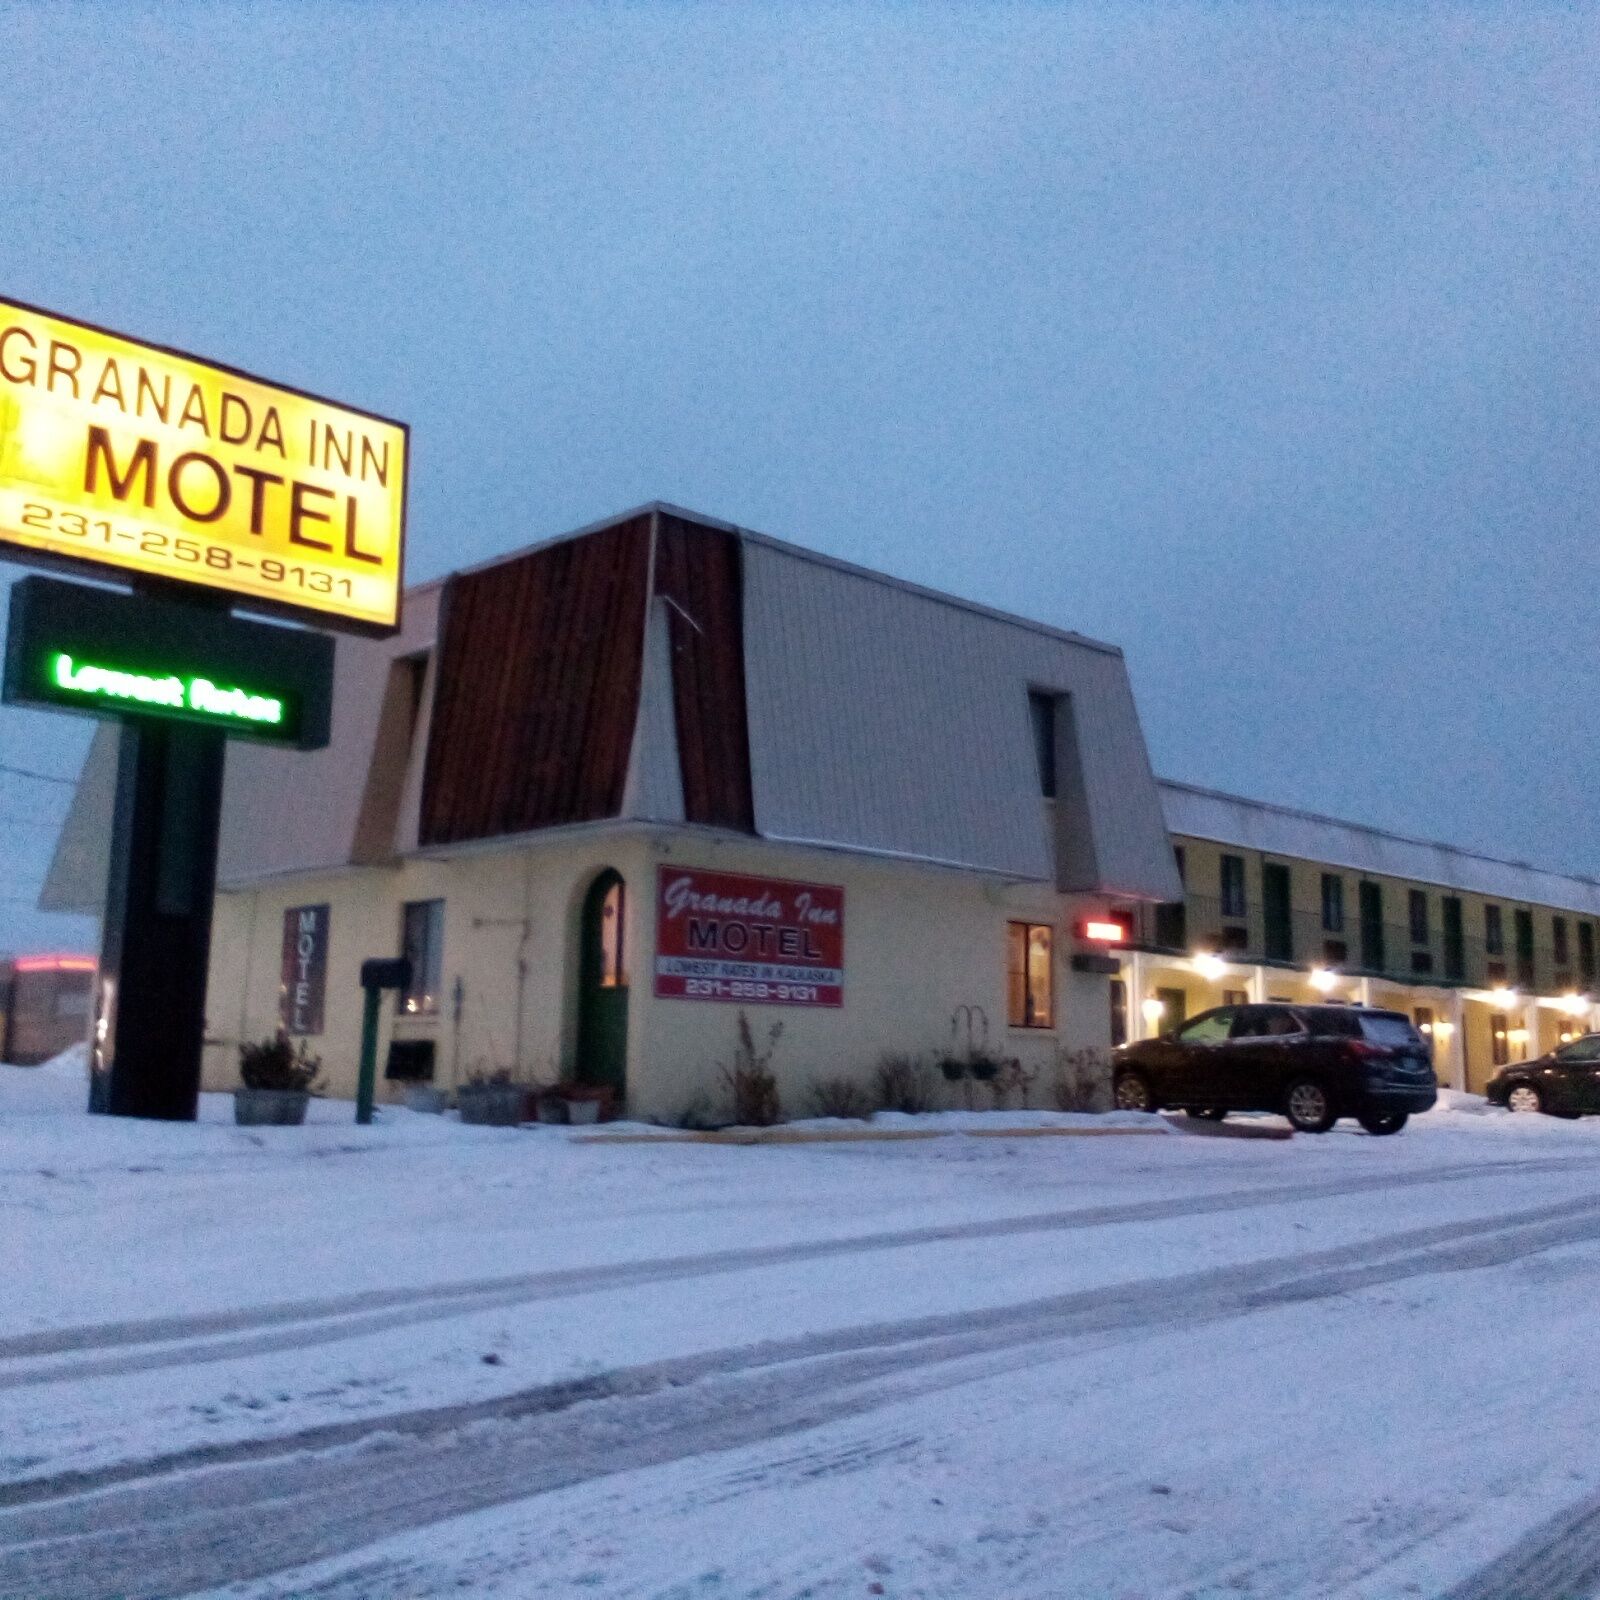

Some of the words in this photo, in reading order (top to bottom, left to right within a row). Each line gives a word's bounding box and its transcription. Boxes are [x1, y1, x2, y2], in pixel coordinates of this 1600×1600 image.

[0, 326, 287, 459] GRANADA
[308, 418, 389, 488] INN
[20, 502, 354, 599] 231-258-9131
[83, 424, 383, 566] MOTEL
[293, 909, 318, 1031] MOTEL
[686, 917, 823, 960] MOTEL
